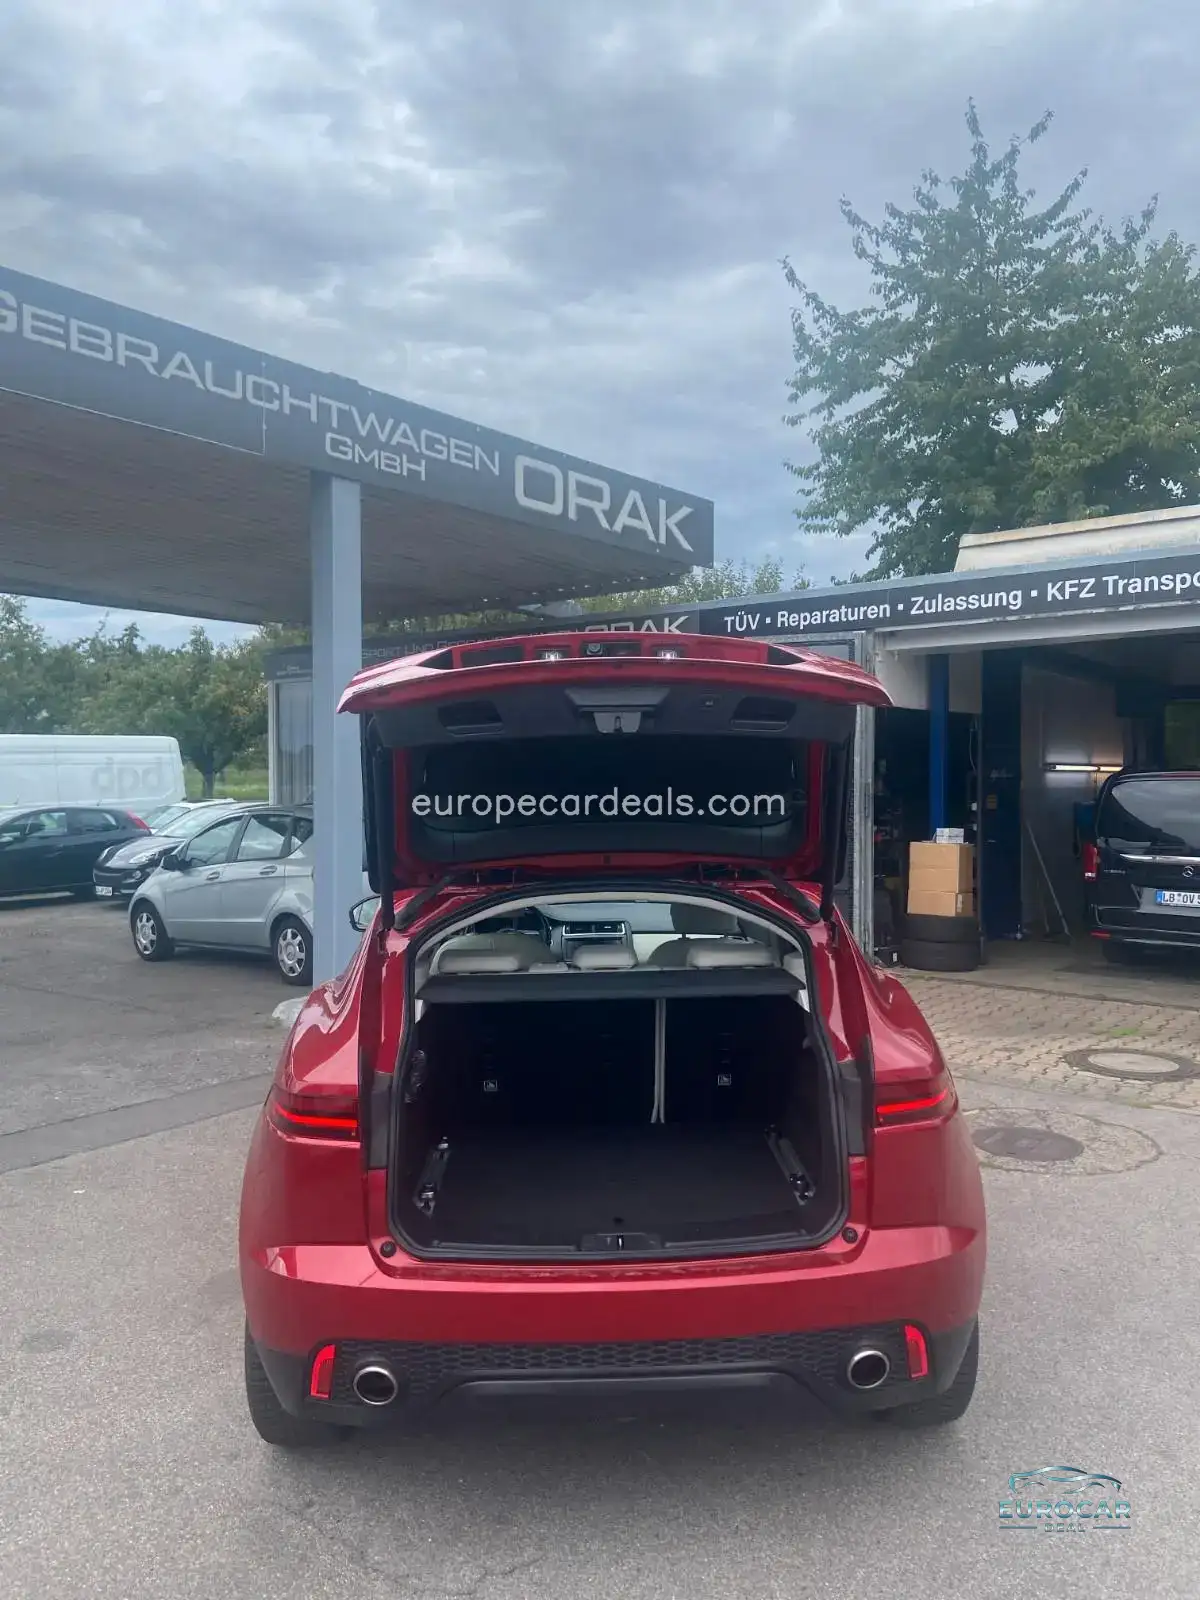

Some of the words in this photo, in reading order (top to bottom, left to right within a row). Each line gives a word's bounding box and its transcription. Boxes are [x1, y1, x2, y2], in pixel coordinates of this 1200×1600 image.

[325, 432, 426, 481] GMBH
[514, 454, 695, 552] ORAK
[724, 611, 760, 633] TÜV
[777, 603, 891, 630] Reparaturen
[910, 589, 1022, 614] Zulassung
[1047, 578, 1096, 601] KFZ
[1163, 893, 1175, 903] LB
